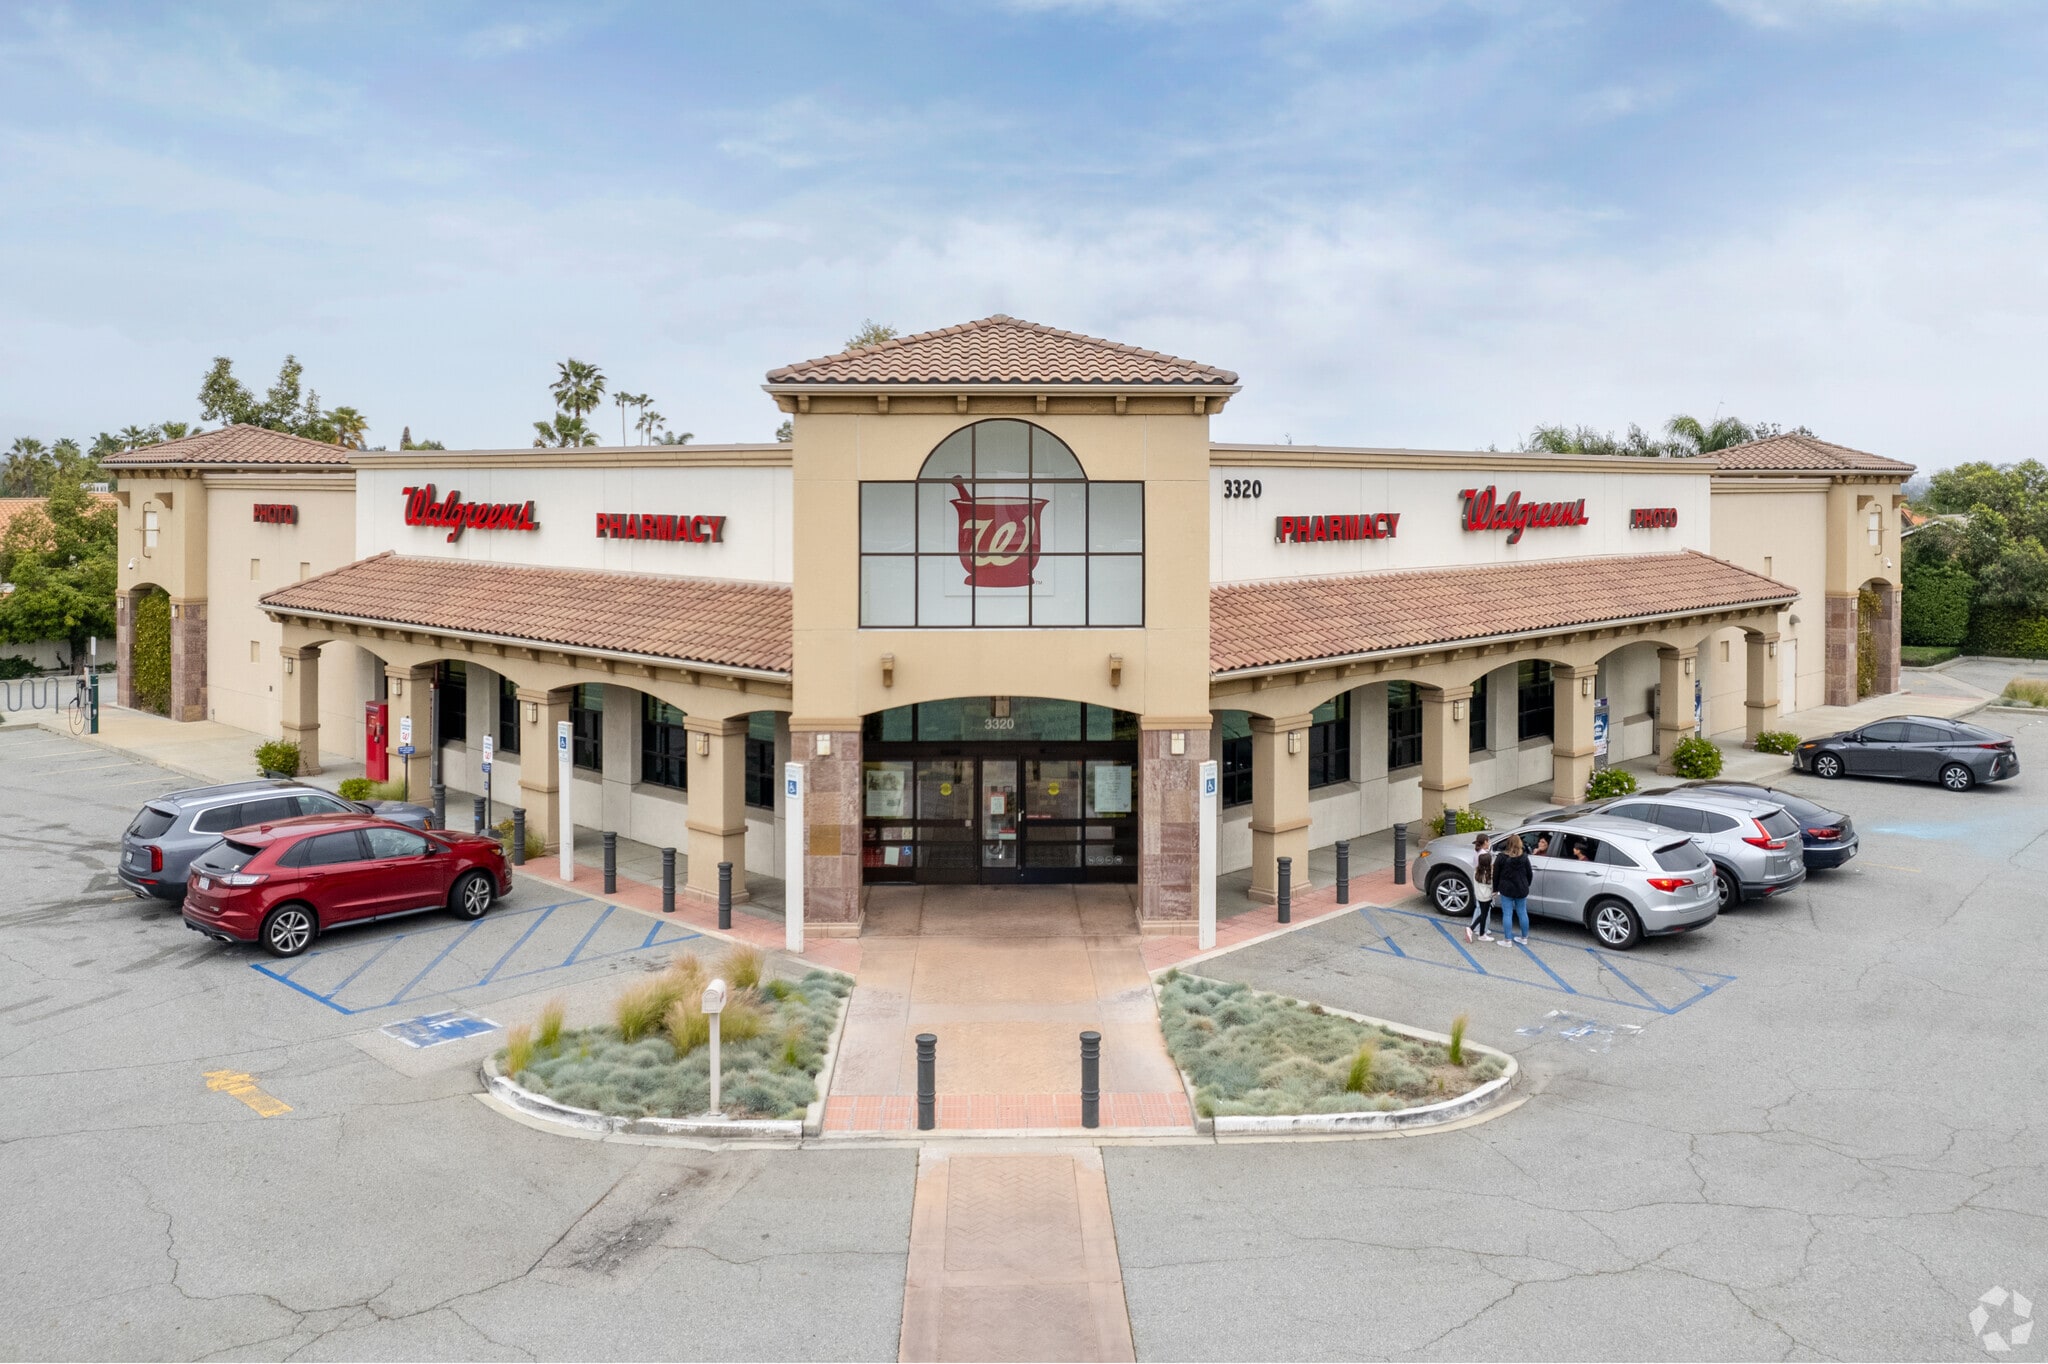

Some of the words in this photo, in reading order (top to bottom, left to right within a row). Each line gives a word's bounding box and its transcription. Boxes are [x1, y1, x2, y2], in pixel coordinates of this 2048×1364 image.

[1224, 479, 1262, 499] 3320
[253, 503, 299, 525] PHOTO
[402, 483, 540, 543] Walgreens
[1458, 485, 1589, 544] Walgreens
[1629, 508, 1678, 530] PHOTO
[596, 513, 727, 543] PHARMACY
[1275, 512, 1401, 543] PHARMACY
[984, 718, 1015, 730] 3320
